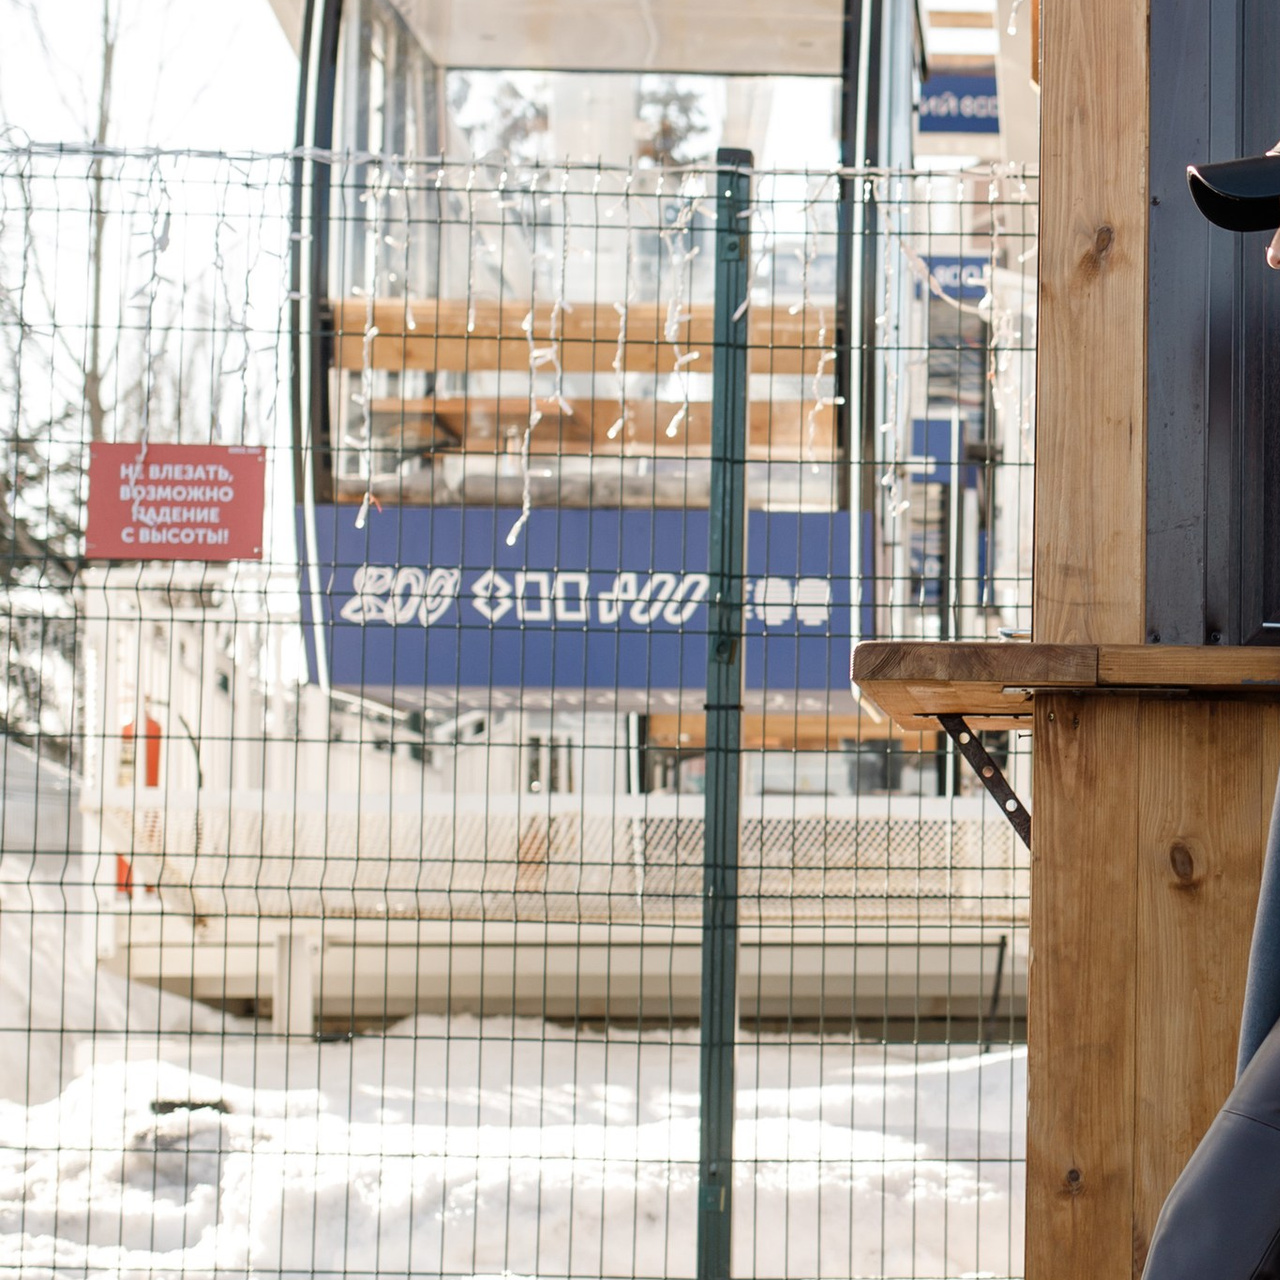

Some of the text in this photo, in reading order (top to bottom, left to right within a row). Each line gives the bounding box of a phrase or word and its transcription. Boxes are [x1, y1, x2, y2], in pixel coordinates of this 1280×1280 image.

[120, 463, 234, 483] НЕ ВЛЕЗАТЬ,
[119, 485, 234, 502] ВОЗМОЖНО
[132, 506, 220, 524] ПАДЕНИЕ
[121, 527, 229, 544] С ВЫСОТЫ!
